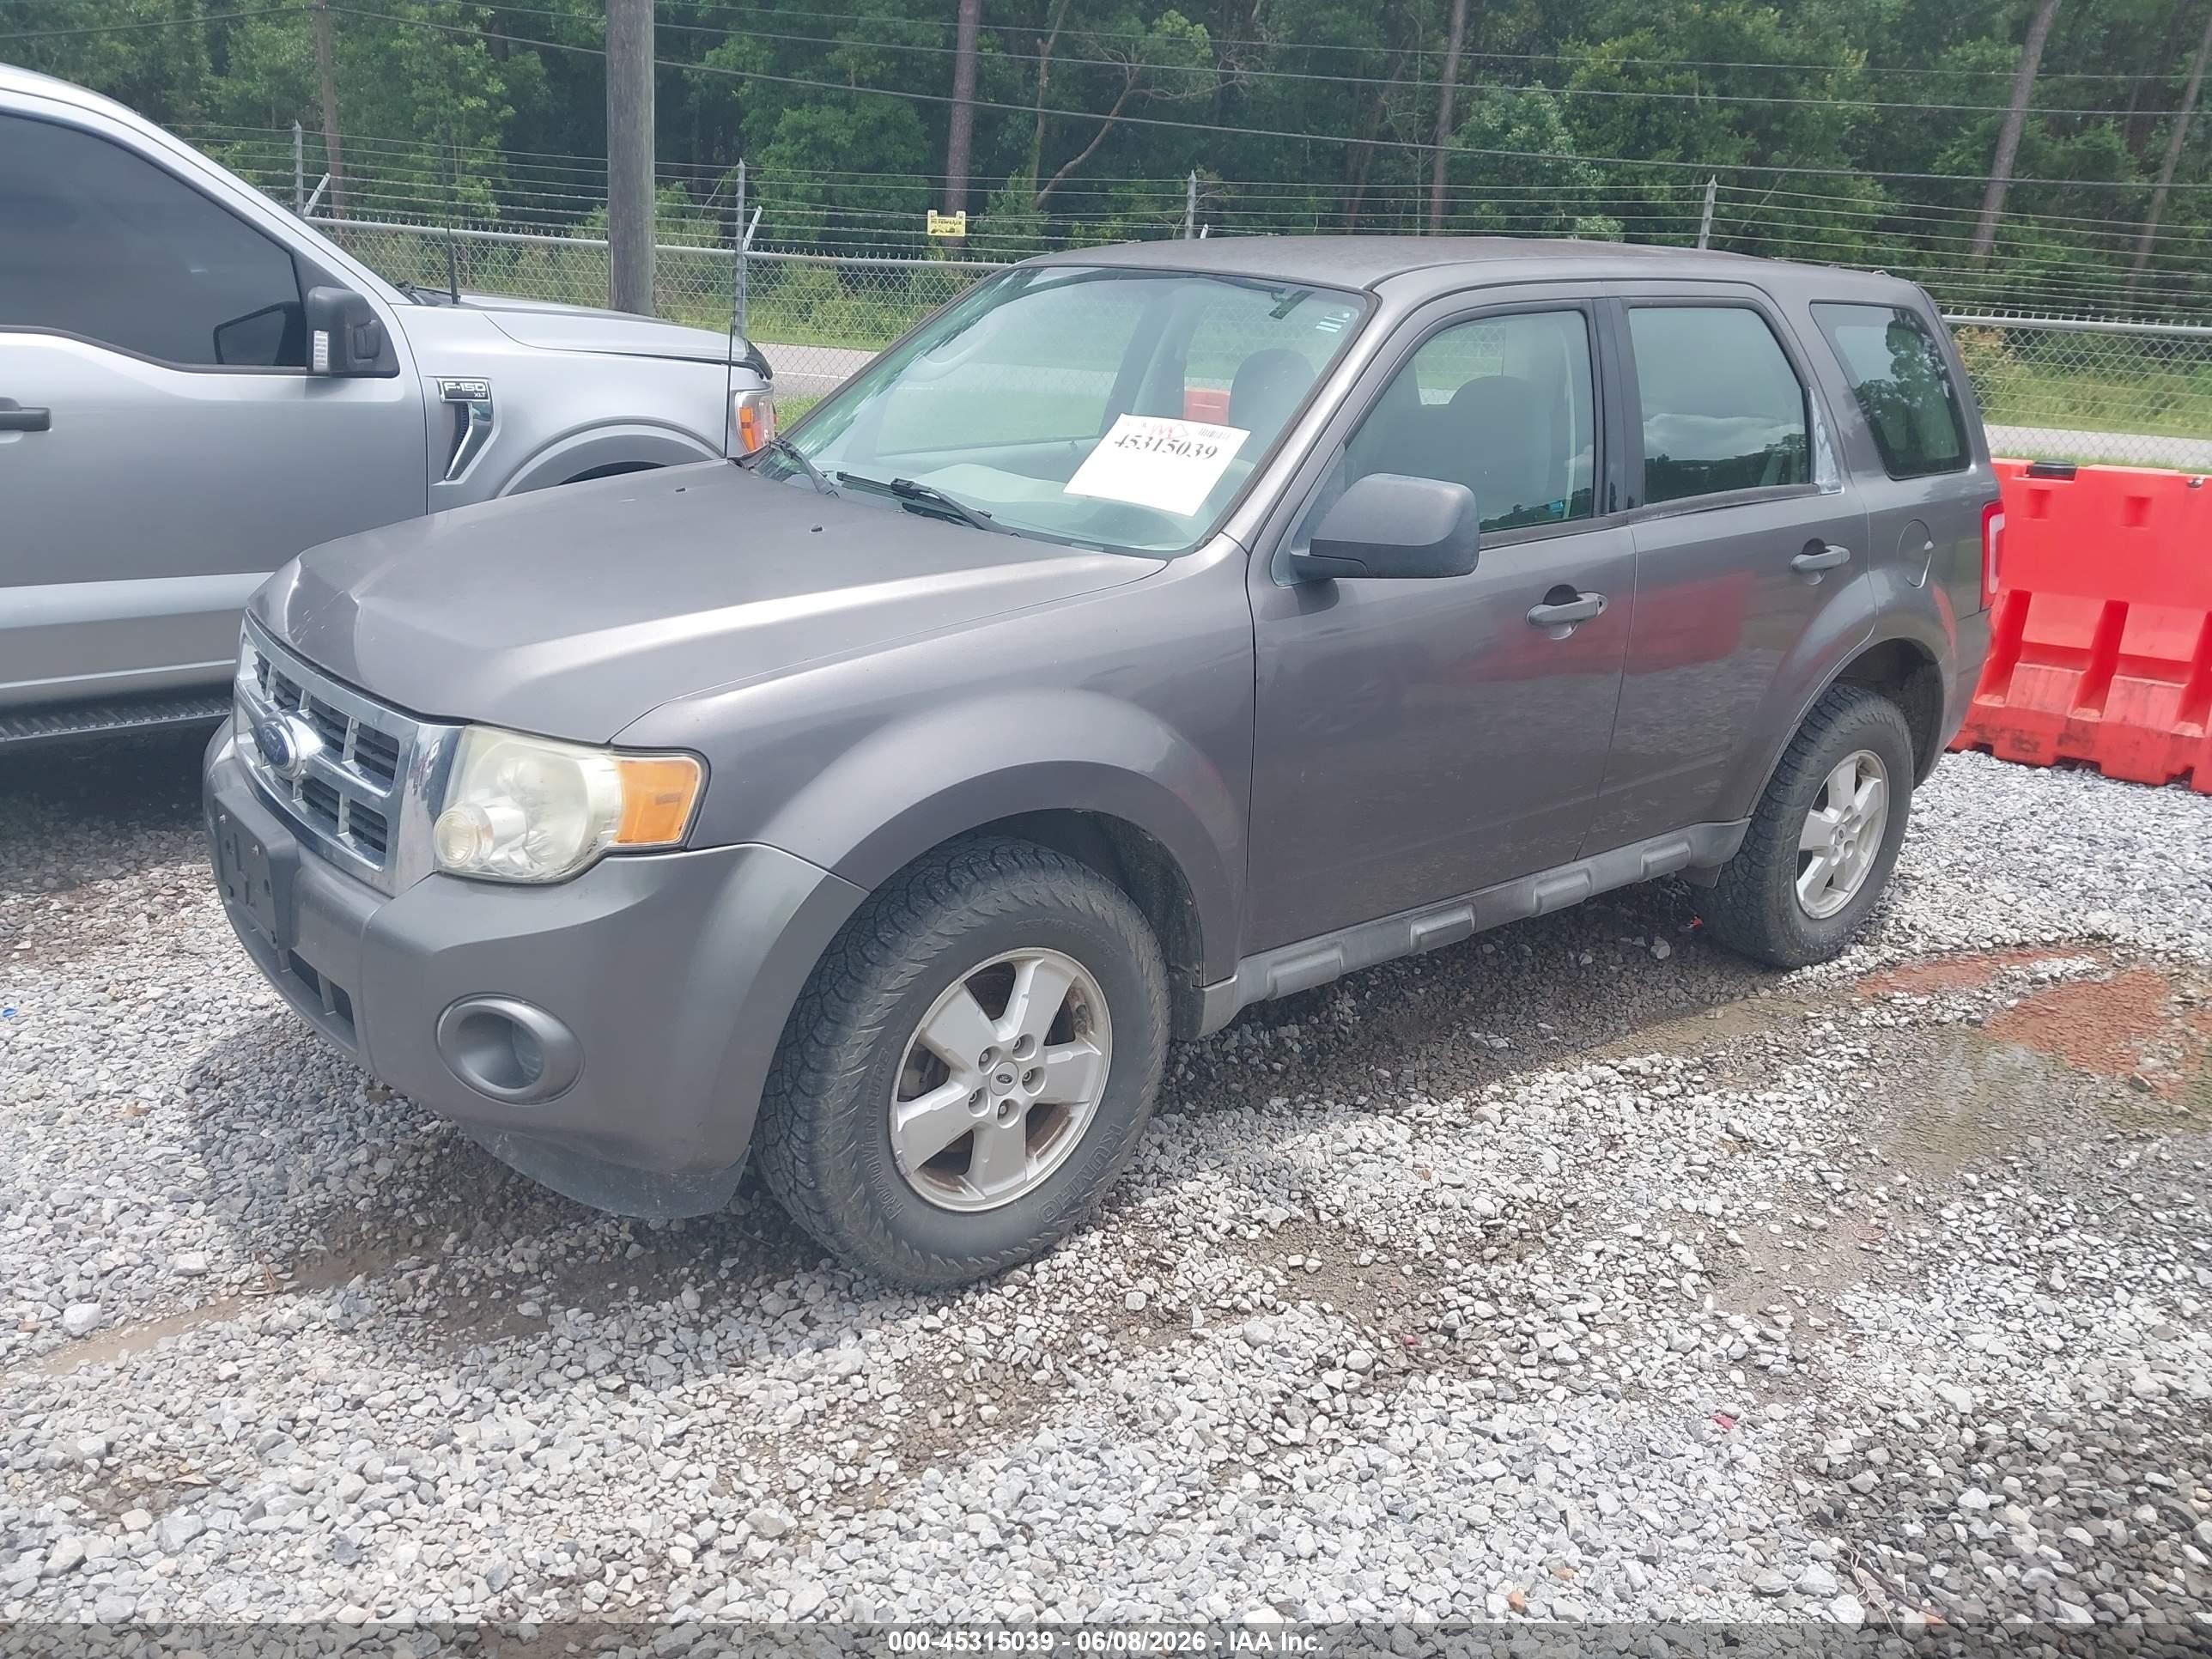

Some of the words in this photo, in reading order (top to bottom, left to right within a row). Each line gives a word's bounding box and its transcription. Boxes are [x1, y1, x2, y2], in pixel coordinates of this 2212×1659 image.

[444, 382, 486, 392] F-150
[1114, 434, 1218, 459] 45315039
[1039, 1123, 1122, 1223] KUMHO
